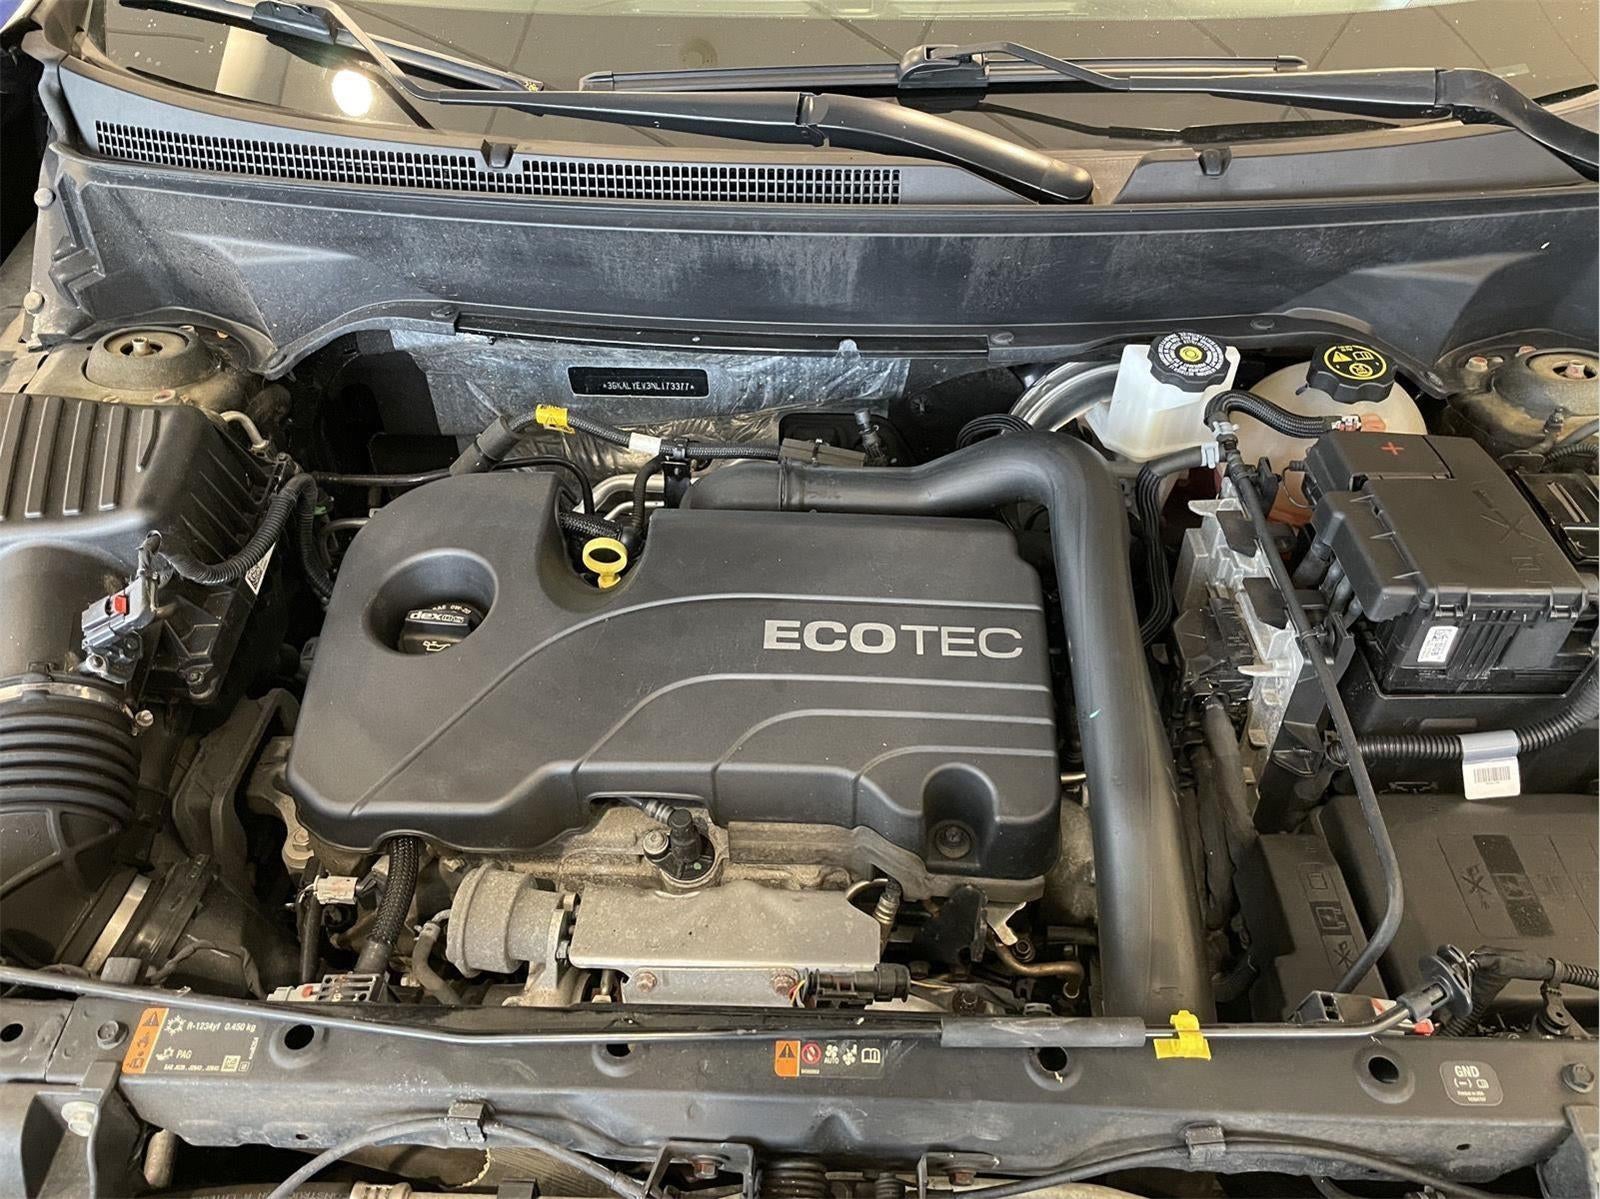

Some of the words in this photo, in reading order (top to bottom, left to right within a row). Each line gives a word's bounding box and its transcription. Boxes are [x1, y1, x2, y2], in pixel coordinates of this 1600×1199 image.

[410, 611, 464, 623] dexos
[763, 620, 1023, 659] ECOTEC
[187, 1022, 221, 1032] R-1234yf
[246, 1023, 256, 1033] kg
[176, 1050, 192, 1059] PAG
[1454, 1065, 1480, 1077] GND
